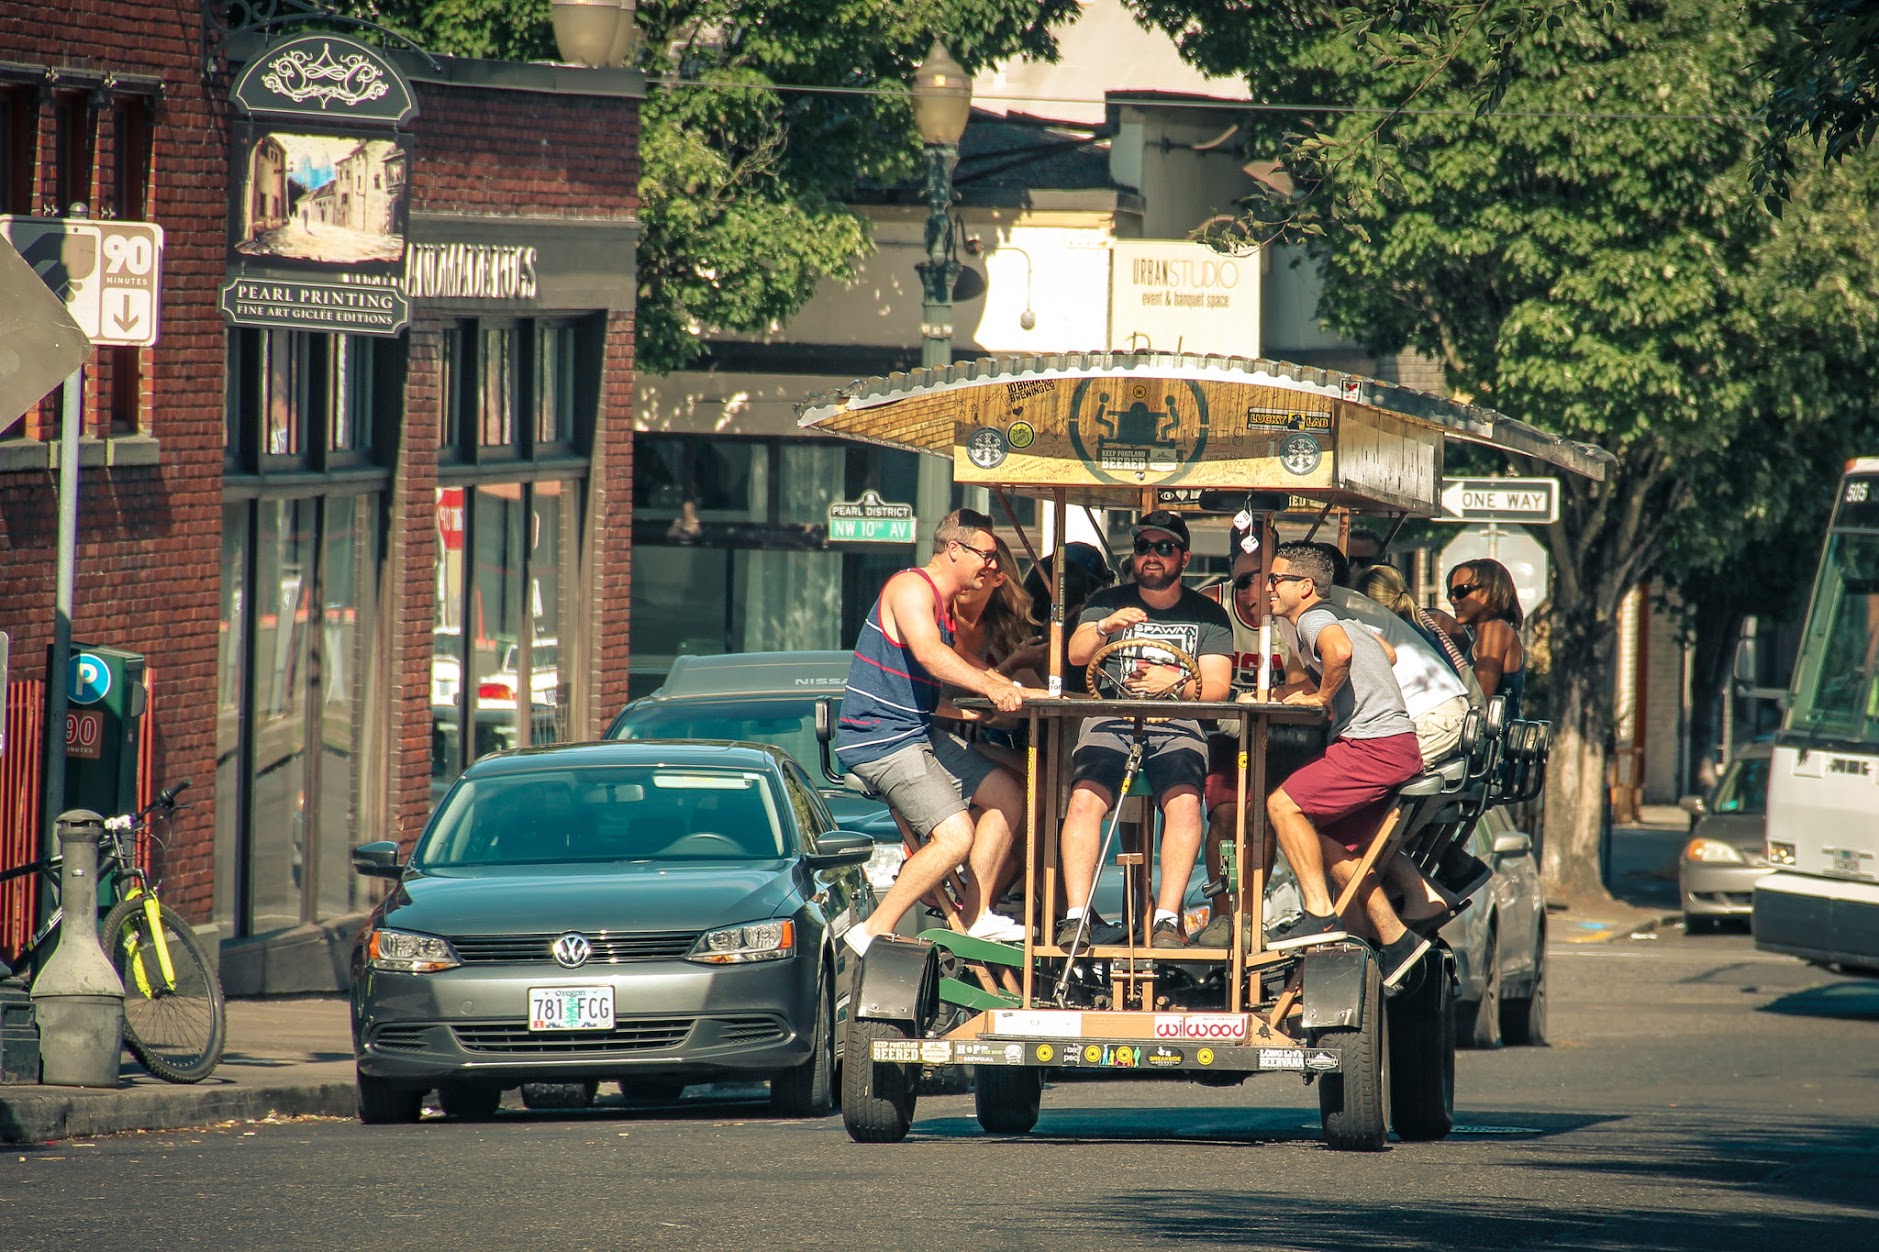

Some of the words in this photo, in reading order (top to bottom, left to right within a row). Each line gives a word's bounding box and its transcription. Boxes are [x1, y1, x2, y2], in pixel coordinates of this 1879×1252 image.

[103, 234, 152, 275] 90
[106, 276, 148, 286] MINUTES
[236, 284, 294, 302] PEARL
[300, 288, 393, 310] PRINTING
[1142, 292, 1162, 306] event
[1165, 291, 1171, 307] &
[1174, 291, 1204, 310] banquet
[1207, 293, 1230, 311] space
[236, 303, 264, 316] FINE
[266, 306, 290, 318] ART
[336, 312, 393, 325] EDITIONS
[1009, 384, 1045, 402] BREWING
[1250, 413, 1287, 425] LUCKY
[1306, 417, 1329, 428] LAB
[1117, 450, 1146, 458] PORTLAND
[1101, 457, 1146, 469] BEERED
[1462, 492, 1496, 508] ONE
[1507, 493, 1542, 509] WAY
[833, 506, 863, 516] PEARL
[866, 507, 909, 517] DISTRICT
[835, 521, 856, 537] NW
[890, 521, 907, 537] AV
[1134, 623, 1188, 634] SPAWN
[76, 663, 98, 696] P
[66, 714, 97, 746] 90
[555, 990, 586, 998] Oregon
[534, 998, 562, 1020] 781
[577, 997, 609, 1020] FCG
[1156, 1017, 1245, 1037] wilwood
[873, 1048, 919, 1061] BEERED
[1259, 1049, 1282, 1058] LONG
